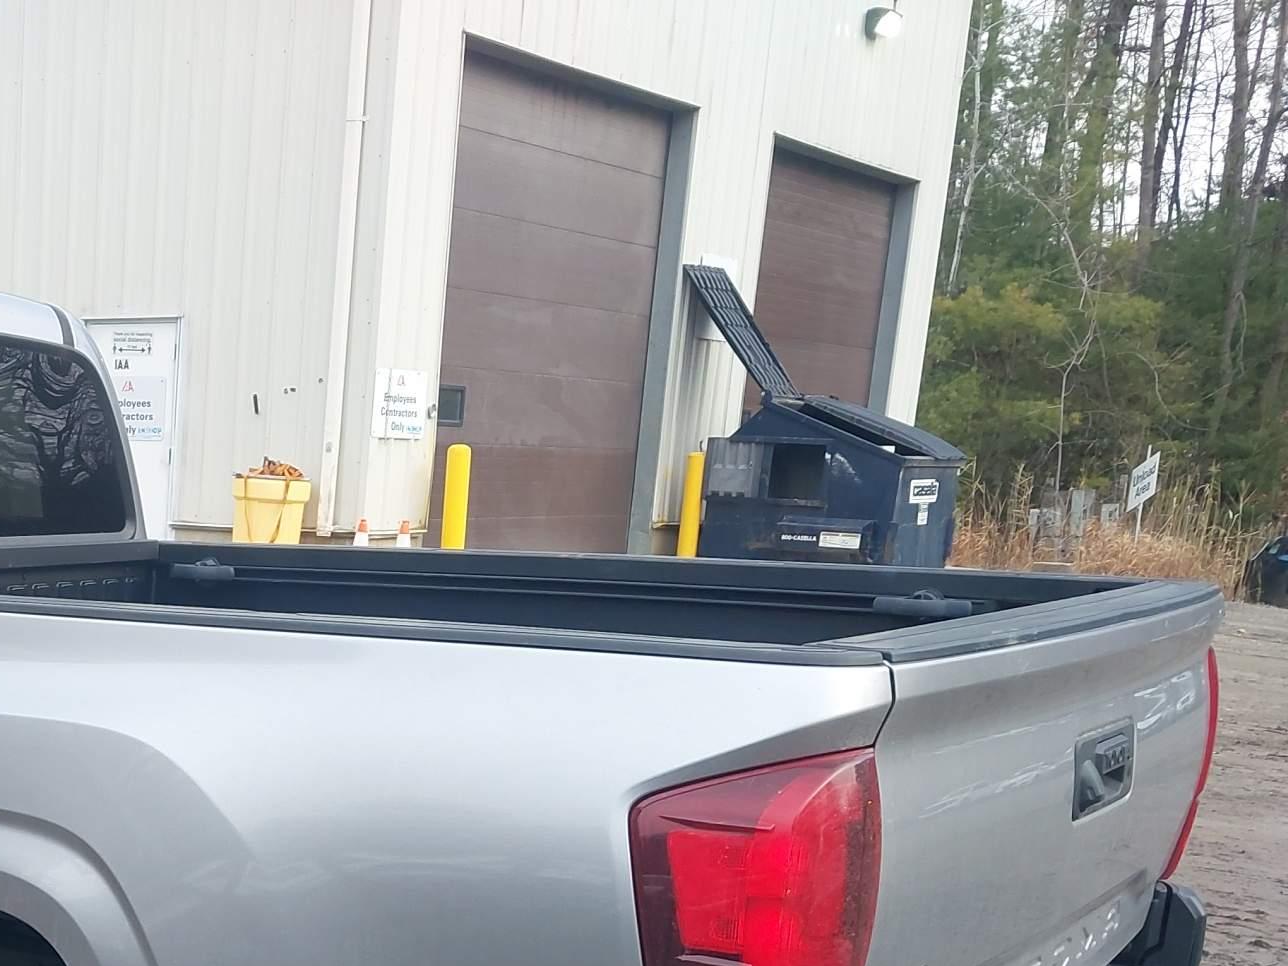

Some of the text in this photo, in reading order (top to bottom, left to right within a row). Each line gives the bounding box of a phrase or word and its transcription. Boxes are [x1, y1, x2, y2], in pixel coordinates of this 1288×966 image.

[114, 359, 130, 370] IAA
[118, 398, 152, 409] ployees
[383, 392, 417, 405] Employees
[380, 406, 418, 418] Contractors
[391, 421, 405, 433] Only
[1134, 482, 1151, 500] Area
